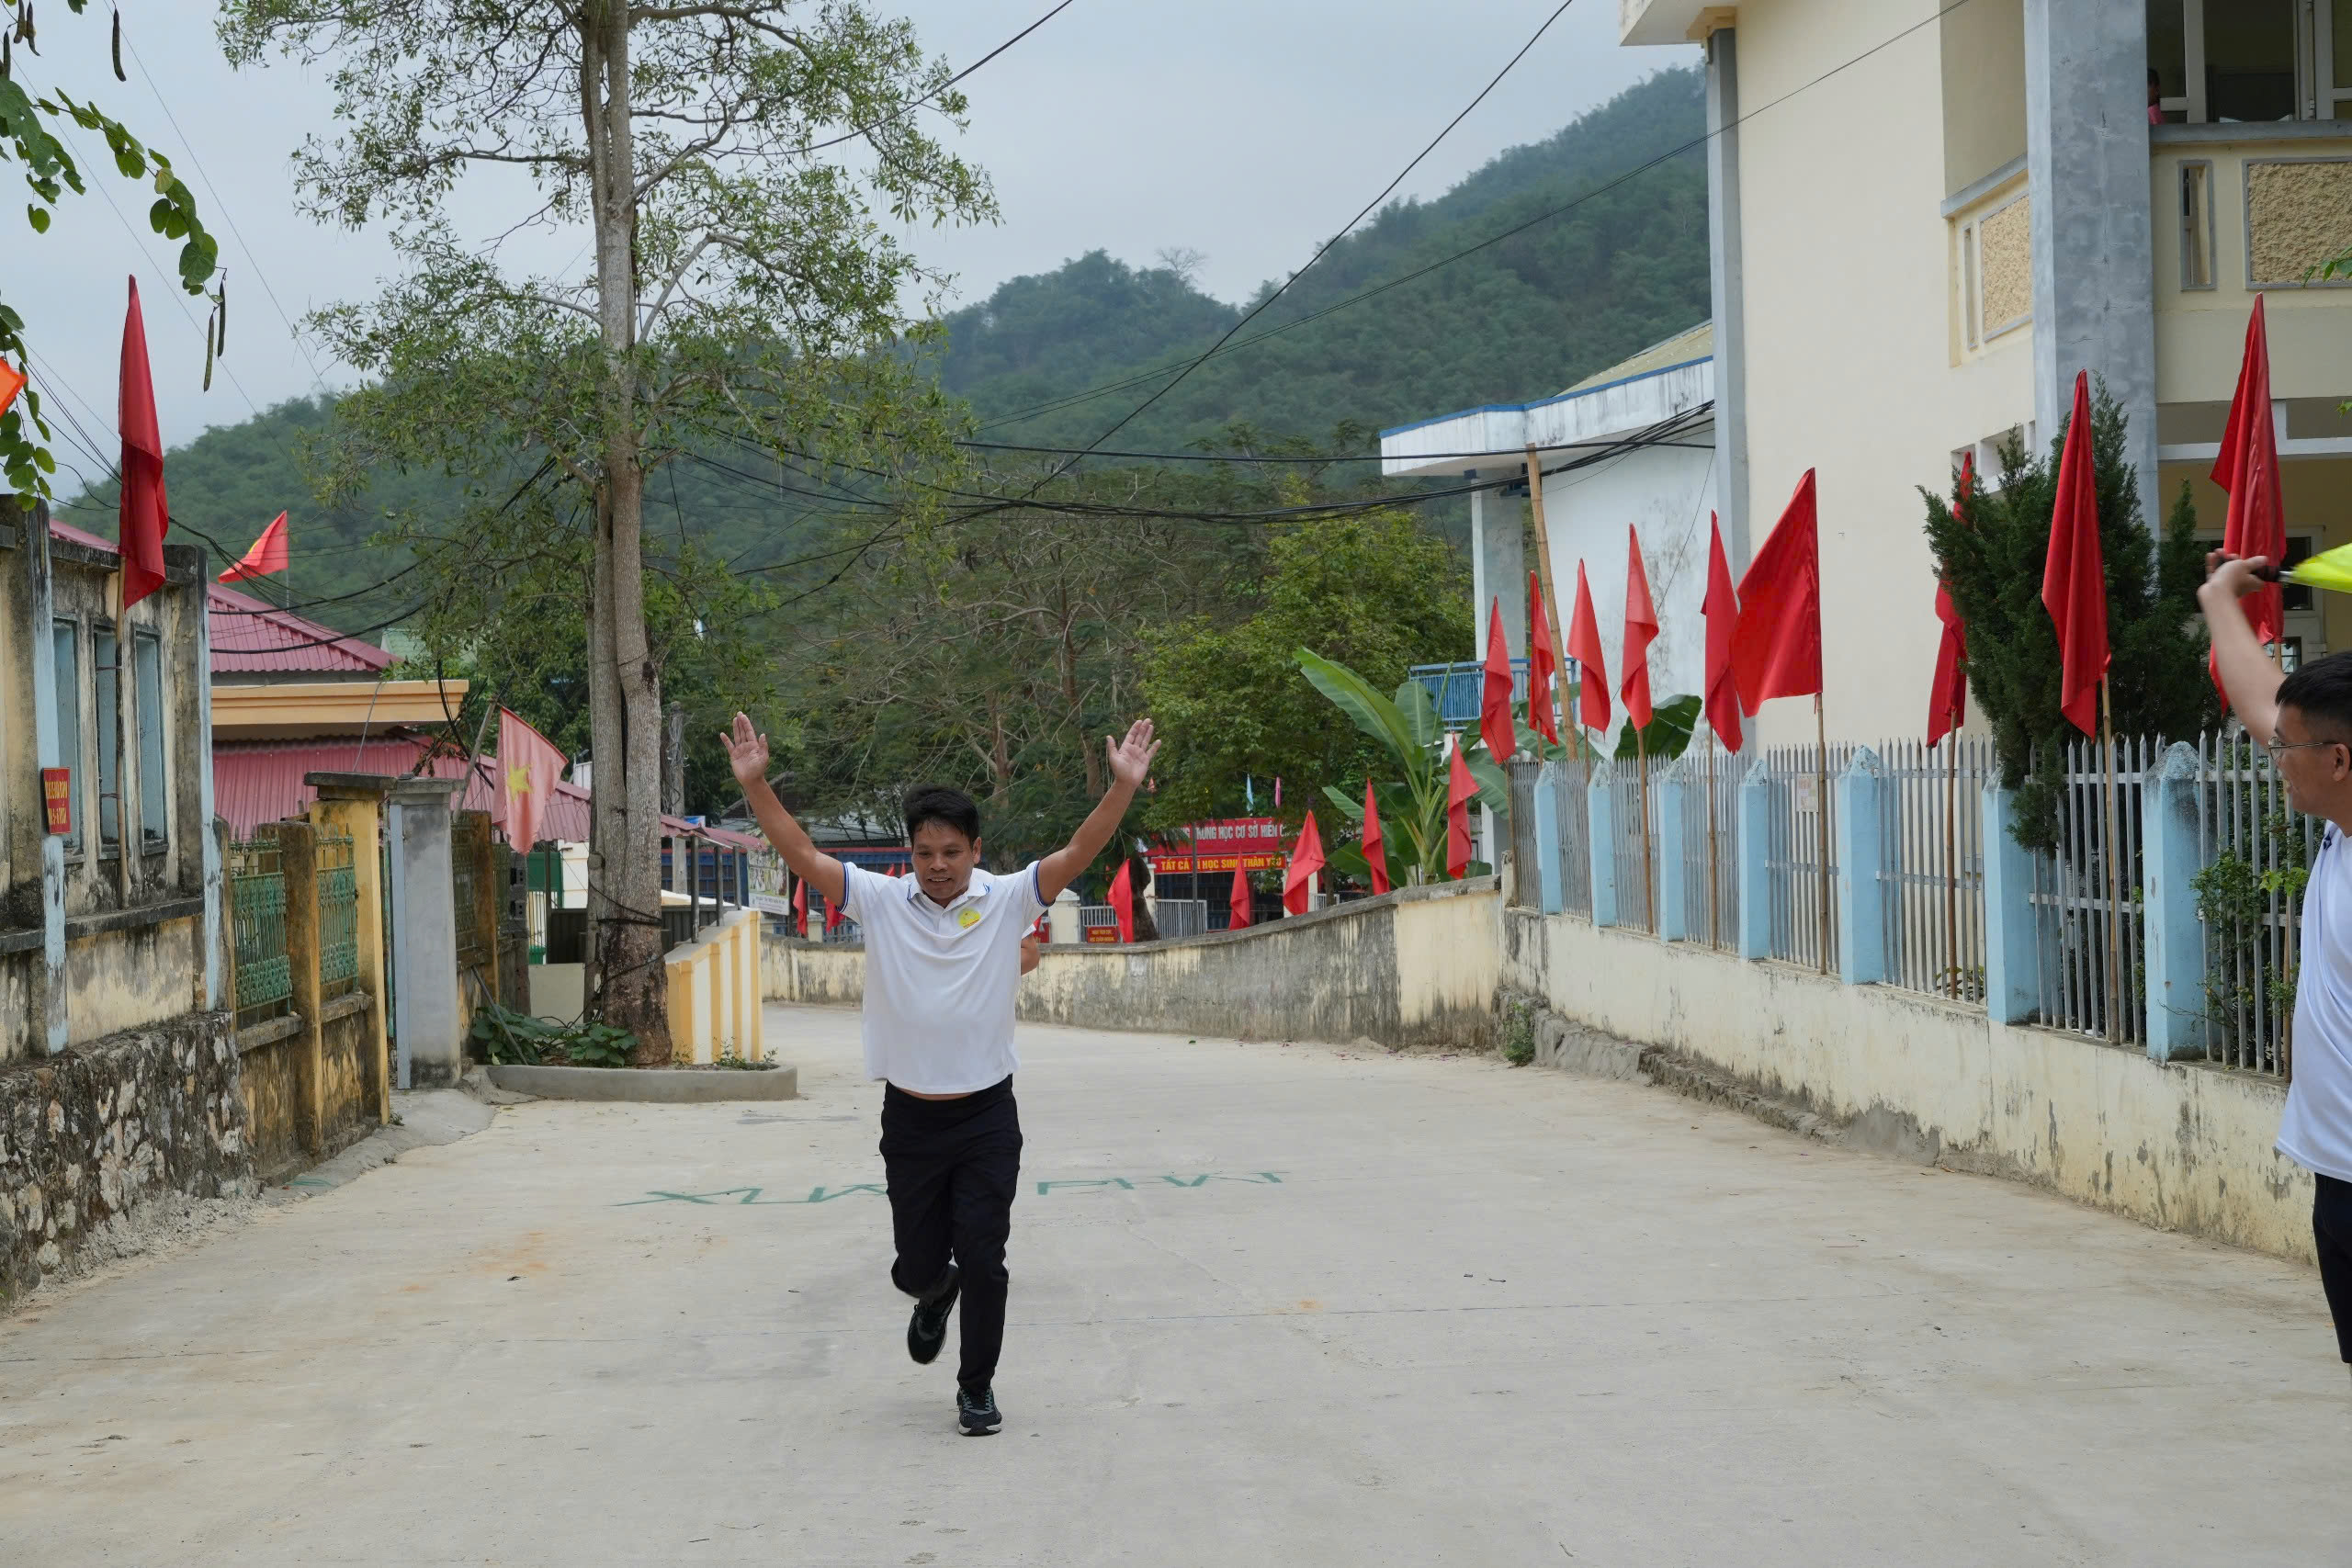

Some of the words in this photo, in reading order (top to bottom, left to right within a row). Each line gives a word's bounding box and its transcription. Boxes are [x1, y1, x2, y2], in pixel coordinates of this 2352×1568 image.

[1218, 825, 1233, 842] HỌC
[1236, 824, 1246, 838] CƠ
[1161, 858, 1176, 871] TẤT
[1177, 858, 1190, 871] CẢ
[1202, 859, 1219, 871] HỌC
[1242, 856, 1265, 868] THÂN
